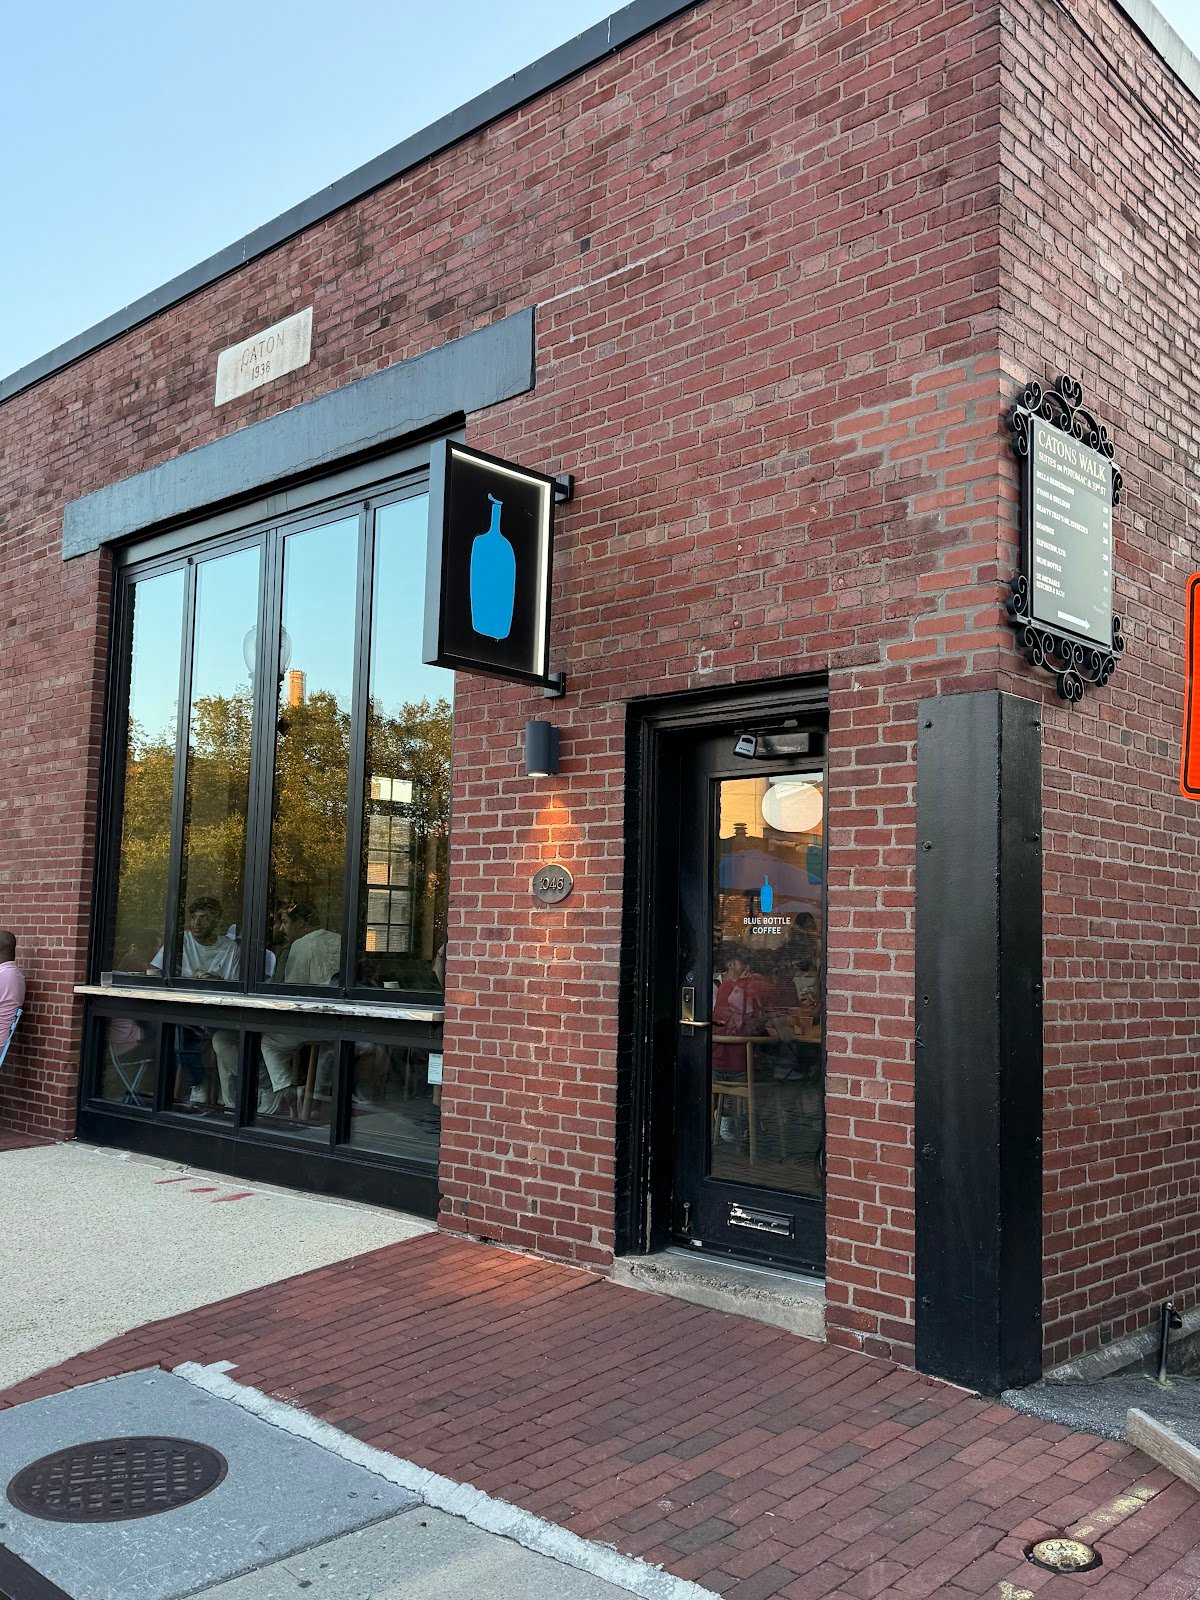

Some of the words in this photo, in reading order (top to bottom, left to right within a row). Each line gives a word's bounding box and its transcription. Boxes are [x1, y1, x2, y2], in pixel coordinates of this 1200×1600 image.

[241, 330, 285, 370] CATON
[251, 360, 271, 381] 1938
[1038, 430, 1077, 465] CATONS
[1078, 452, 1107, 483] WALK
[1038, 451, 1057, 469] SUITES
[1063, 464, 1088, 486] POTOMAC
[540, 877, 565, 890] 1046
[743, 917, 762, 925] BLUE
[763, 916, 791, 925] BOTTLE
[752, 926, 781, 935] COFFEE
